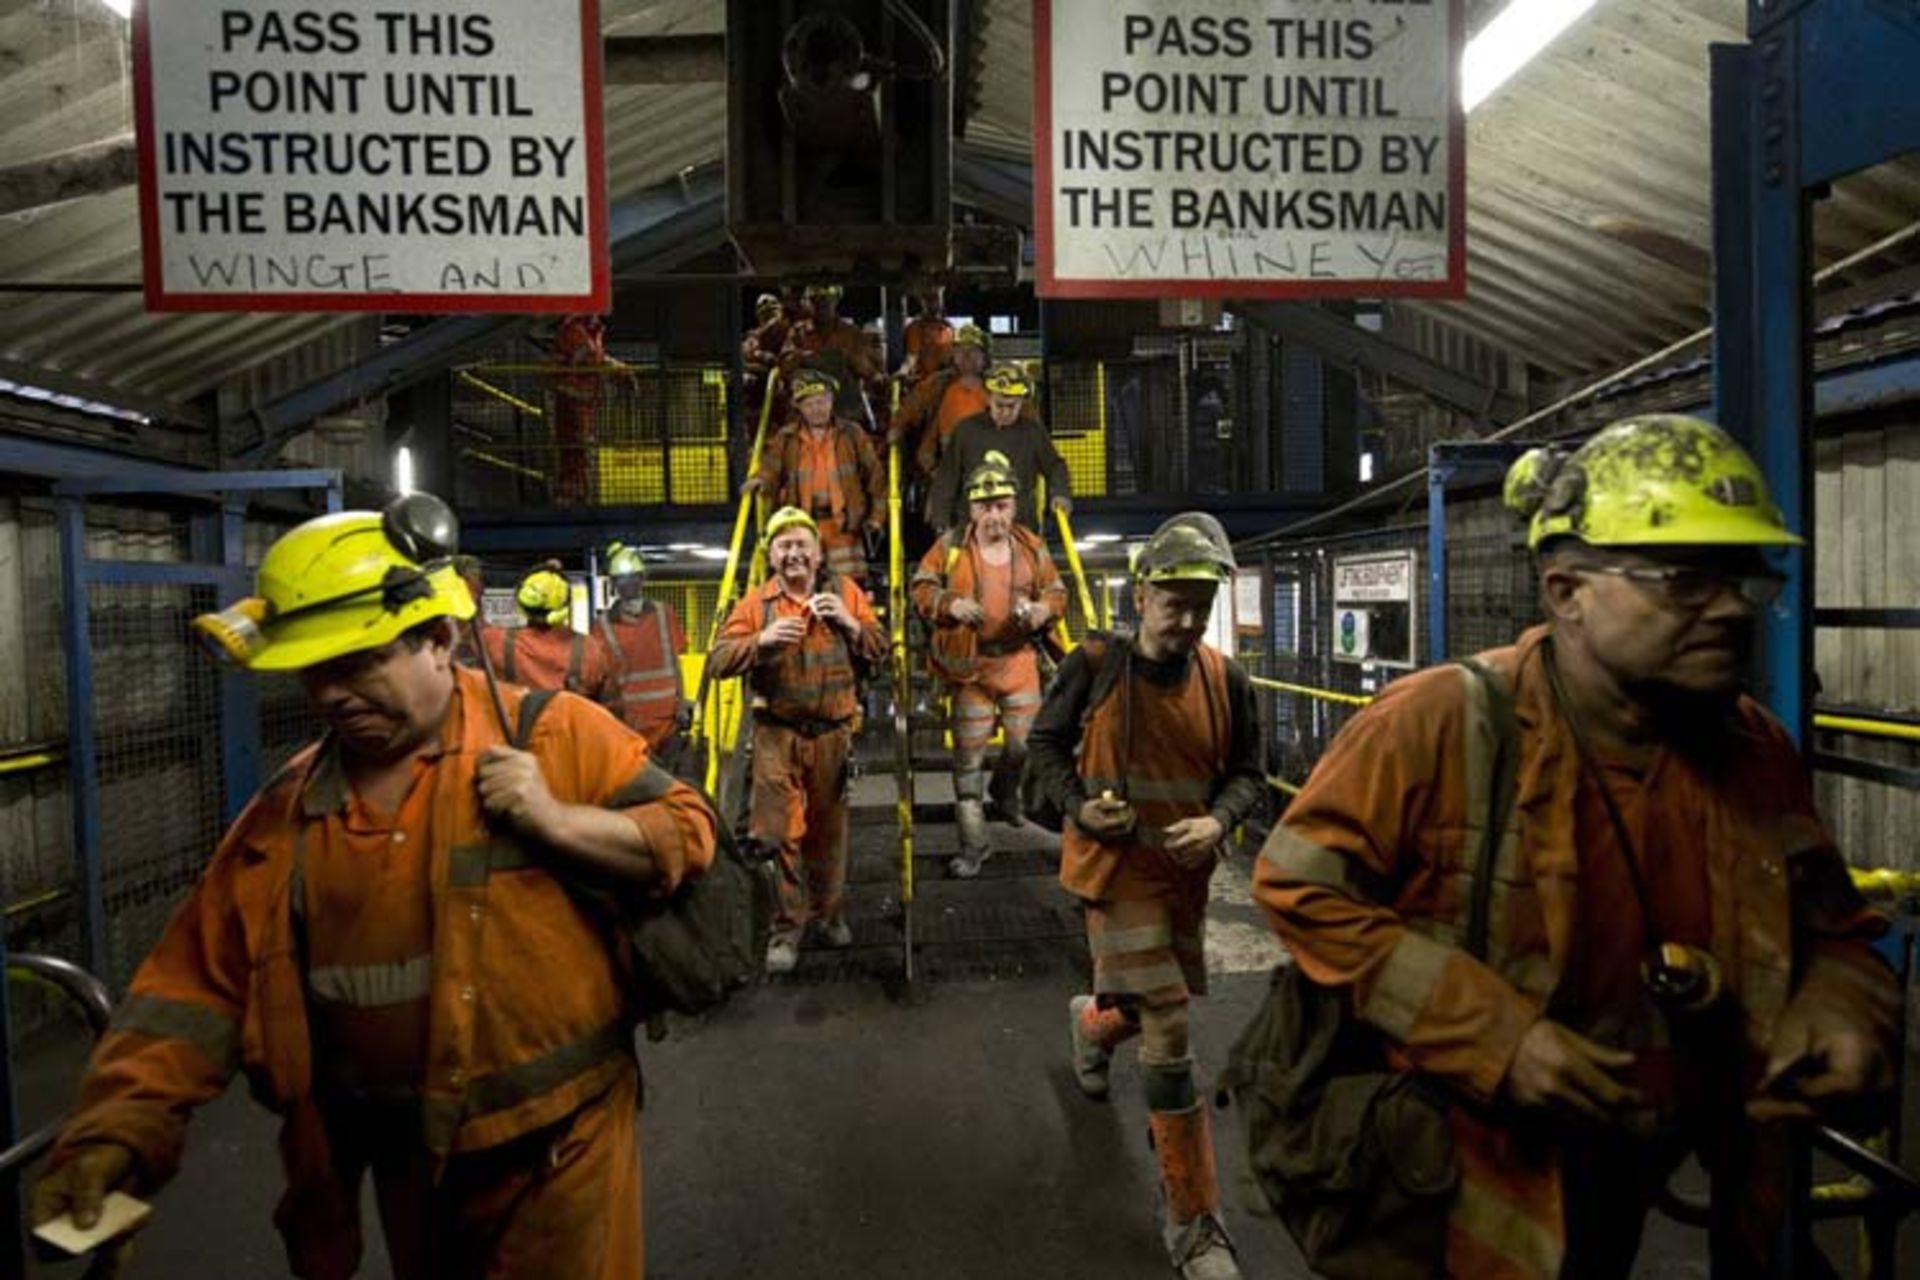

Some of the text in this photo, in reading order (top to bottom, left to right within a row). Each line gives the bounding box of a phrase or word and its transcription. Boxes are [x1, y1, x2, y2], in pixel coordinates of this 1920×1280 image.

[221, 11, 494, 57] PASS THIS
[1125, 15, 1373, 60] PASS THIS
[208, 71, 533, 117] POINT UNTIL
[1102, 72, 1397, 118] POINT UNTIL
[164, 132, 575, 178] INSTRUCTED BY
[1063, 130, 1440, 174] INSTRUCTED BY
[164, 192, 583, 236] THE BANKSMAN
[1061, 188, 1445, 231] THE BANKSMAN
[189, 253, 545, 292] WINGE AND
